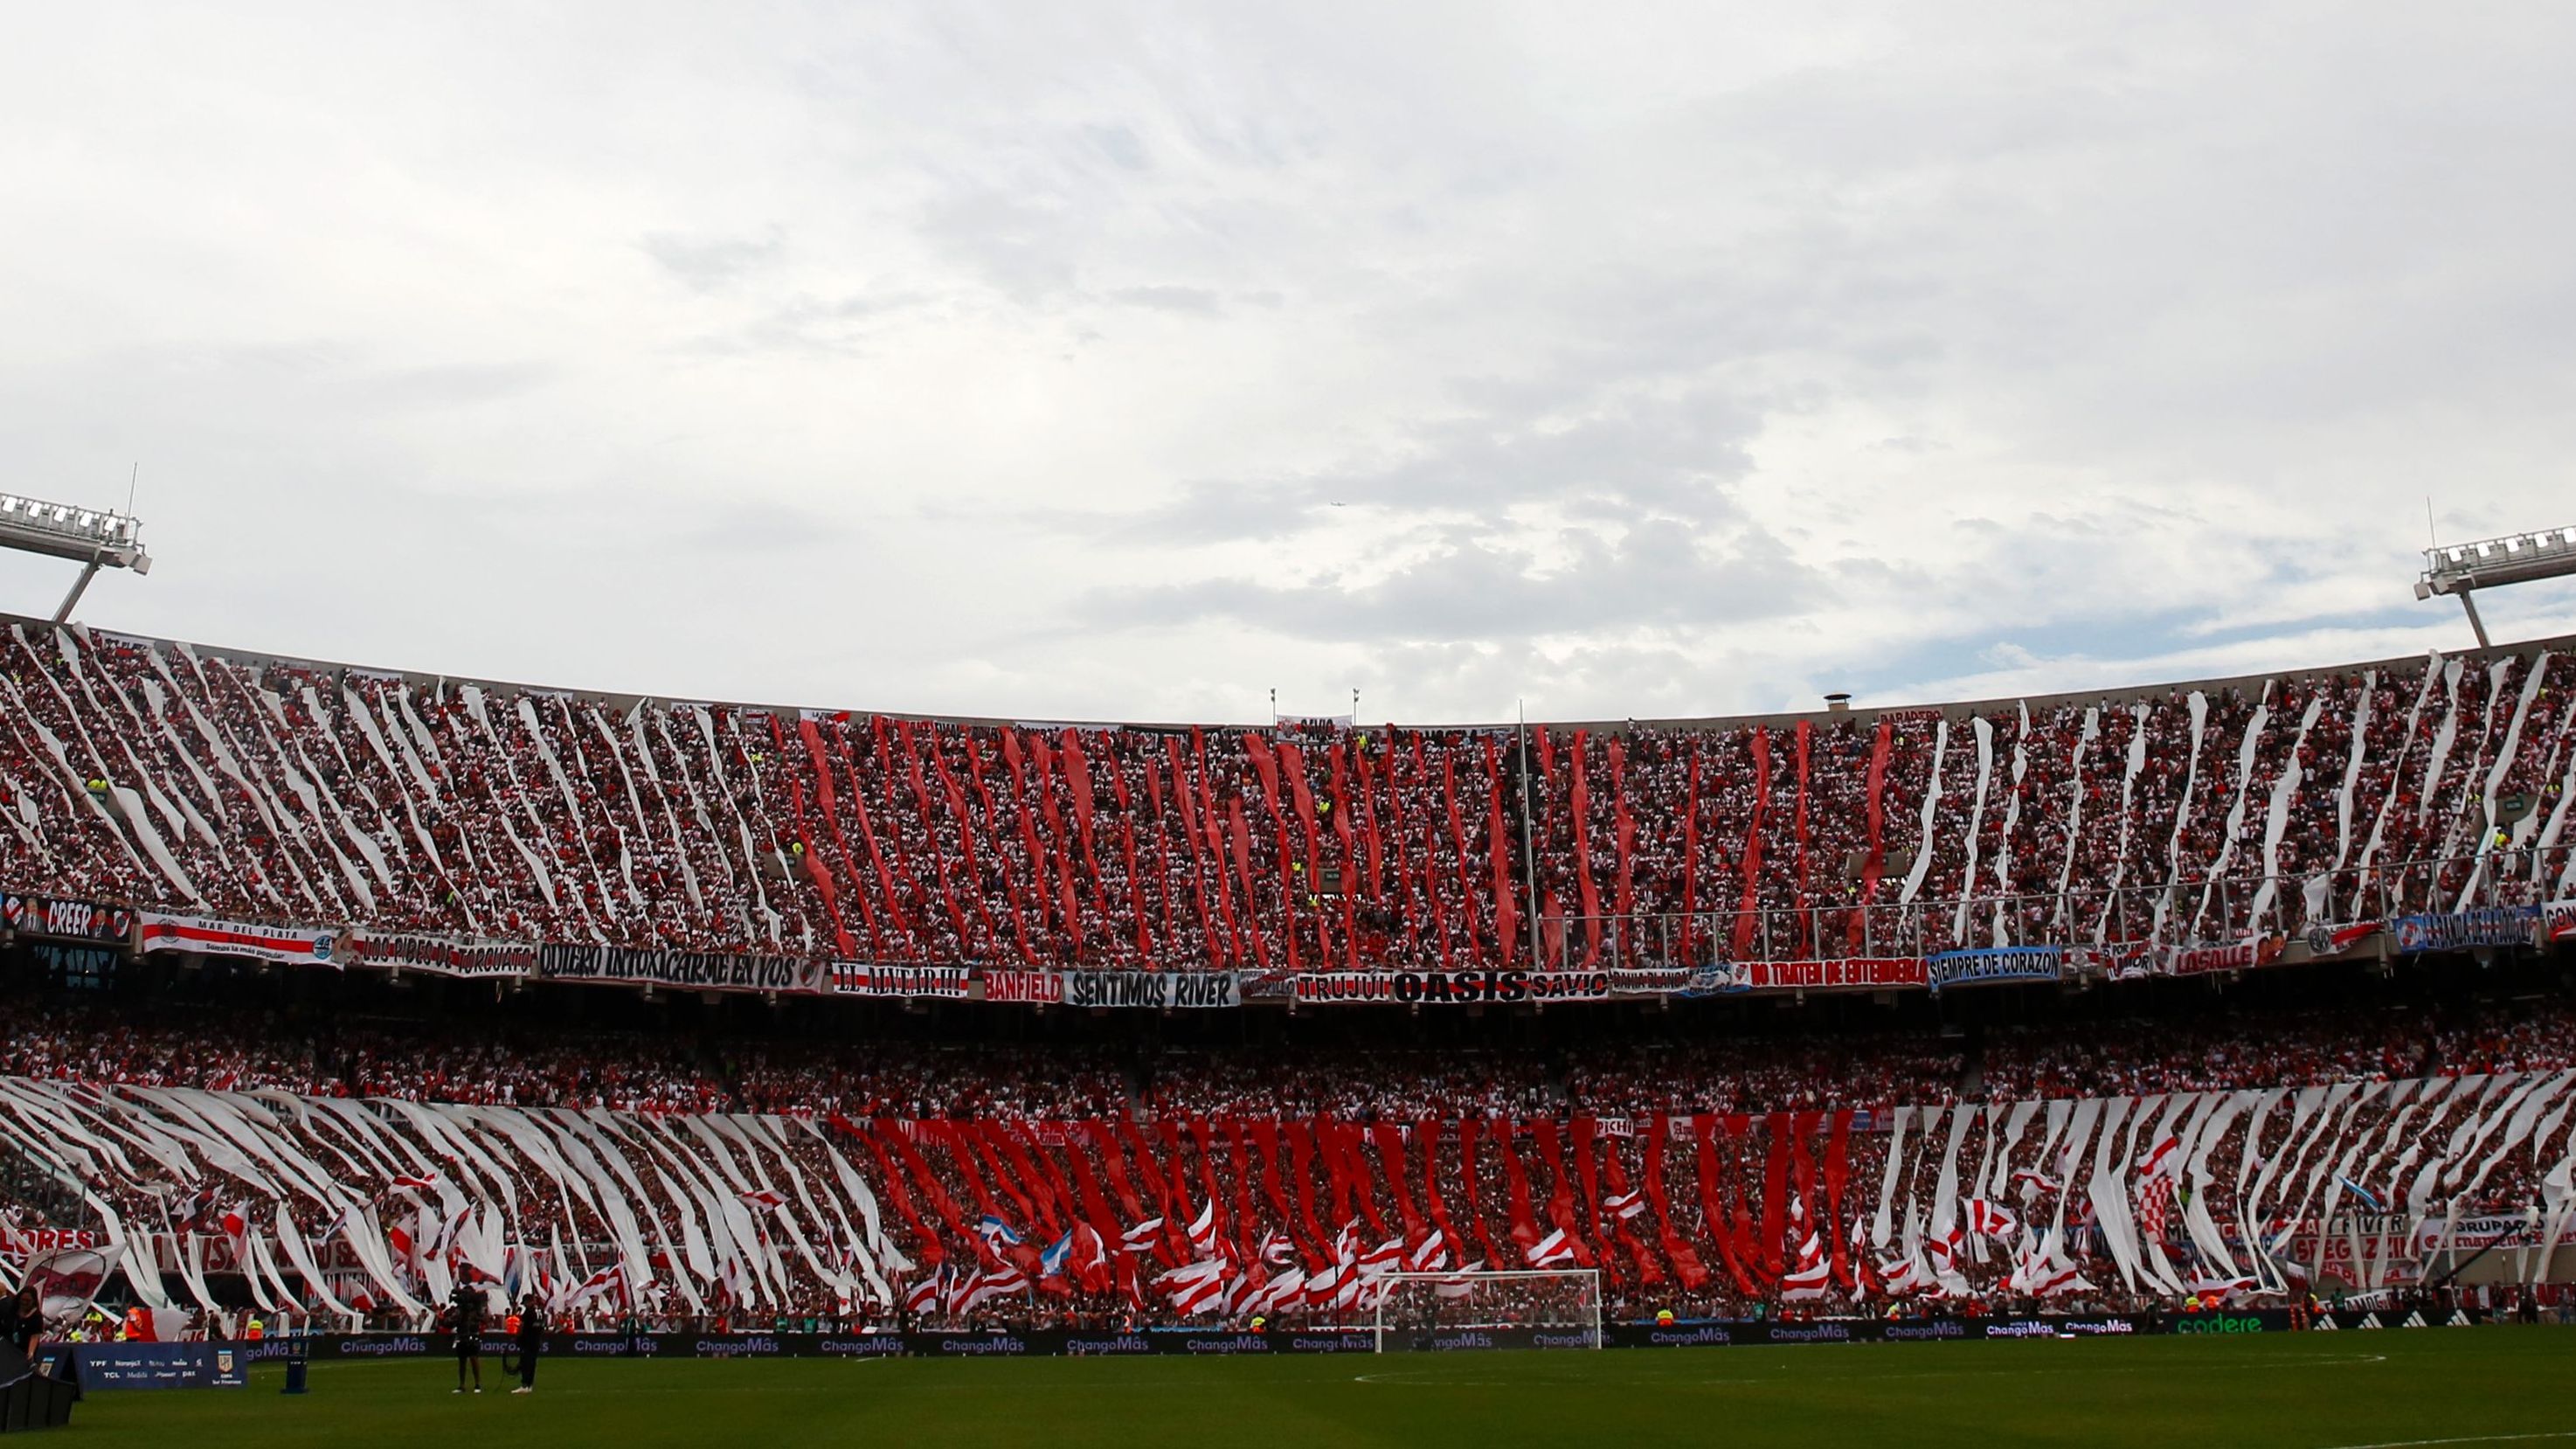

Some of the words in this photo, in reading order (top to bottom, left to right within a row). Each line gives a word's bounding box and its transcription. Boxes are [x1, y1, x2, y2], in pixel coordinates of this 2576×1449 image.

[48, 900, 92, 936] CREER
[197, 920, 224, 932] MAR
[233, 925, 253, 935] DEL
[263, 928, 298, 939] PLATA
[205, 943, 230, 953] Somos
[256, 949, 285, 960] popular
[363, 935, 389, 963] LOS
[393, 938, 432, 965] PIBES
[435, 941, 454, 969] DE
[458, 946, 533, 974] TORCUATO
[2113, 944, 2129, 955] POR
[540, 942, 602, 976] QUIERO
[605, 944, 728, 985] INTOXICARME
[730, 953, 756, 985] EN
[757, 955, 797, 988] VOS
[838, 964, 860, 992] EL
[1749, 962, 1769, 986] NO
[1770, 961, 1823, 986] TRATEN
[1825, 960, 1843, 986] DE
[1845, 958, 1928, 986] ENTENDERLO
[1929, 953, 1981, 985] SIEMPRE
[1983, 953, 1999, 975] DE
[982, 970, 1063, 1002] BANFIELD
[1072, 971, 1167, 1006] SENTIMOS
[1174, 973, 1232, 1006] RIVER
[1299, 974, 1385, 1001] TRUJUI
[1395, 970, 1528, 1002] OASIS
[1532, 973, 1609, 998] SAVIO
[2178, 1312, 2263, 1335] codere
